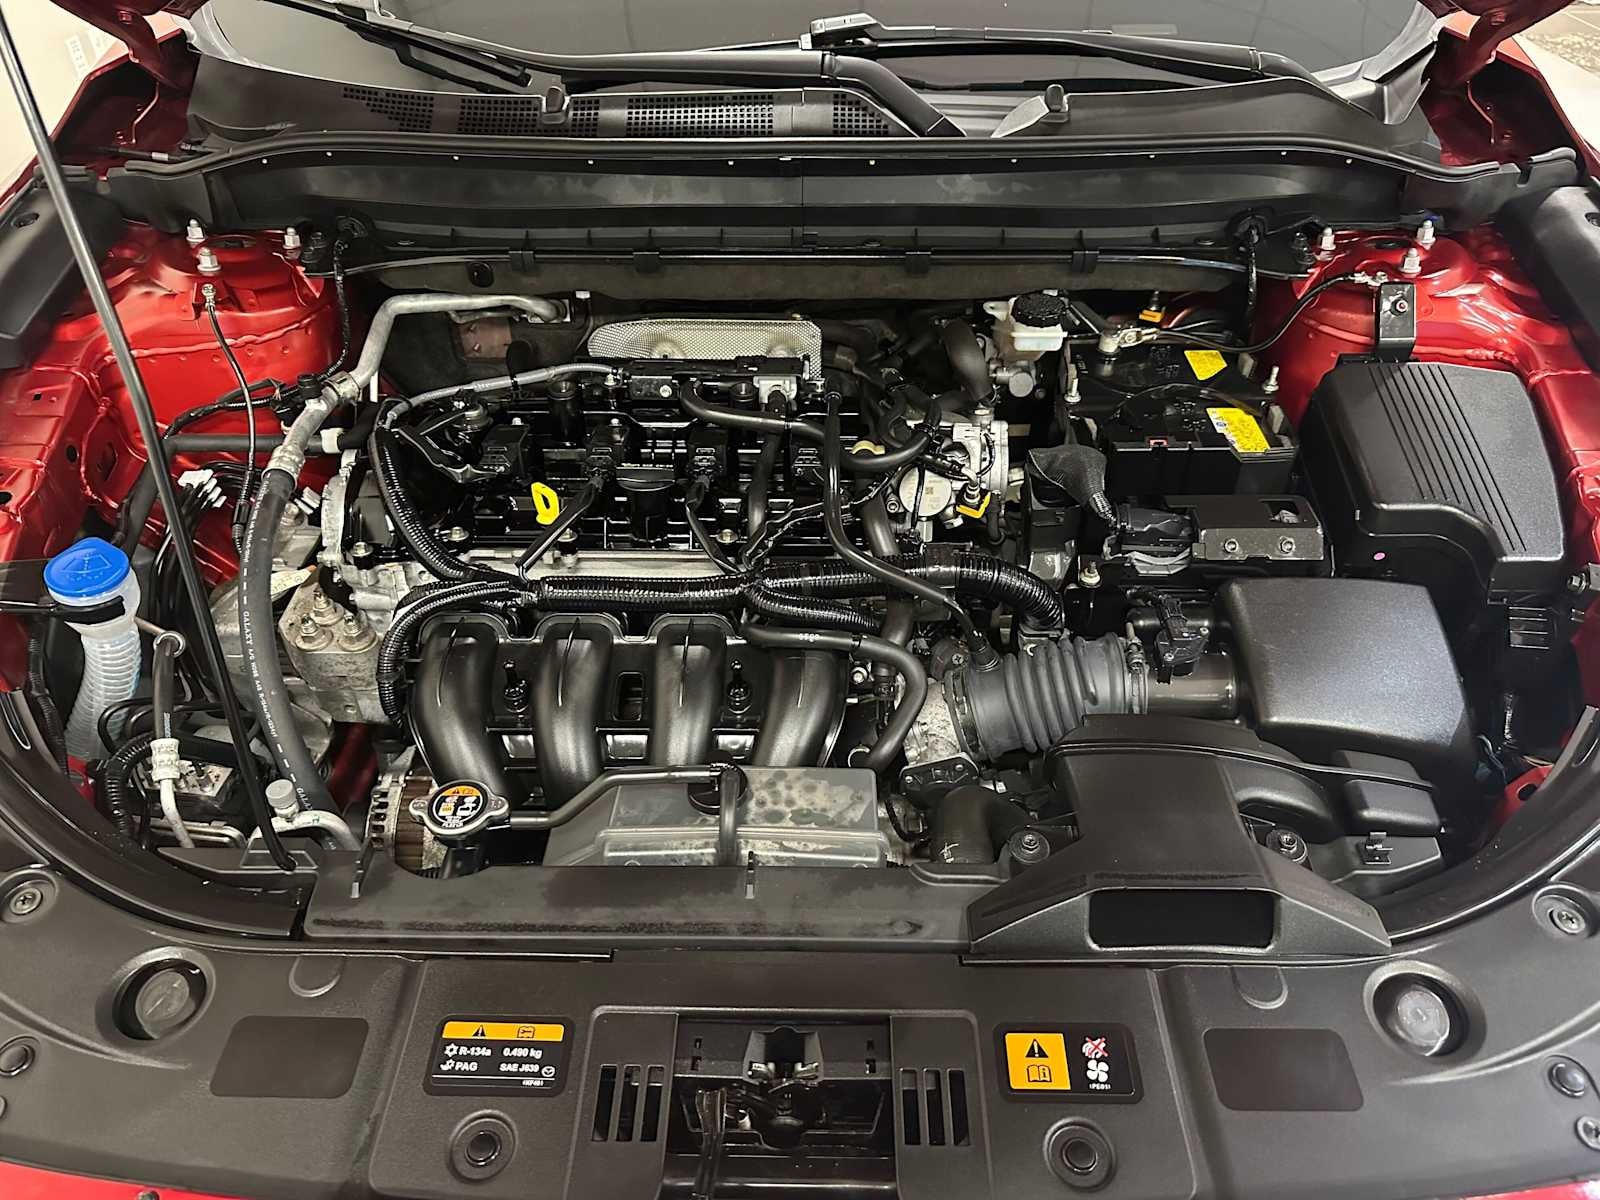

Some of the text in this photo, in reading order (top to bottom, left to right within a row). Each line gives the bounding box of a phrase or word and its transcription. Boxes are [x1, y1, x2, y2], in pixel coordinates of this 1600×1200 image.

[243, 611, 254, 645] GALAXY
[458, 1046, 543, 1059] R-134a 0.490 kg
[455, 1061, 539, 1072] PAG SAE J639
